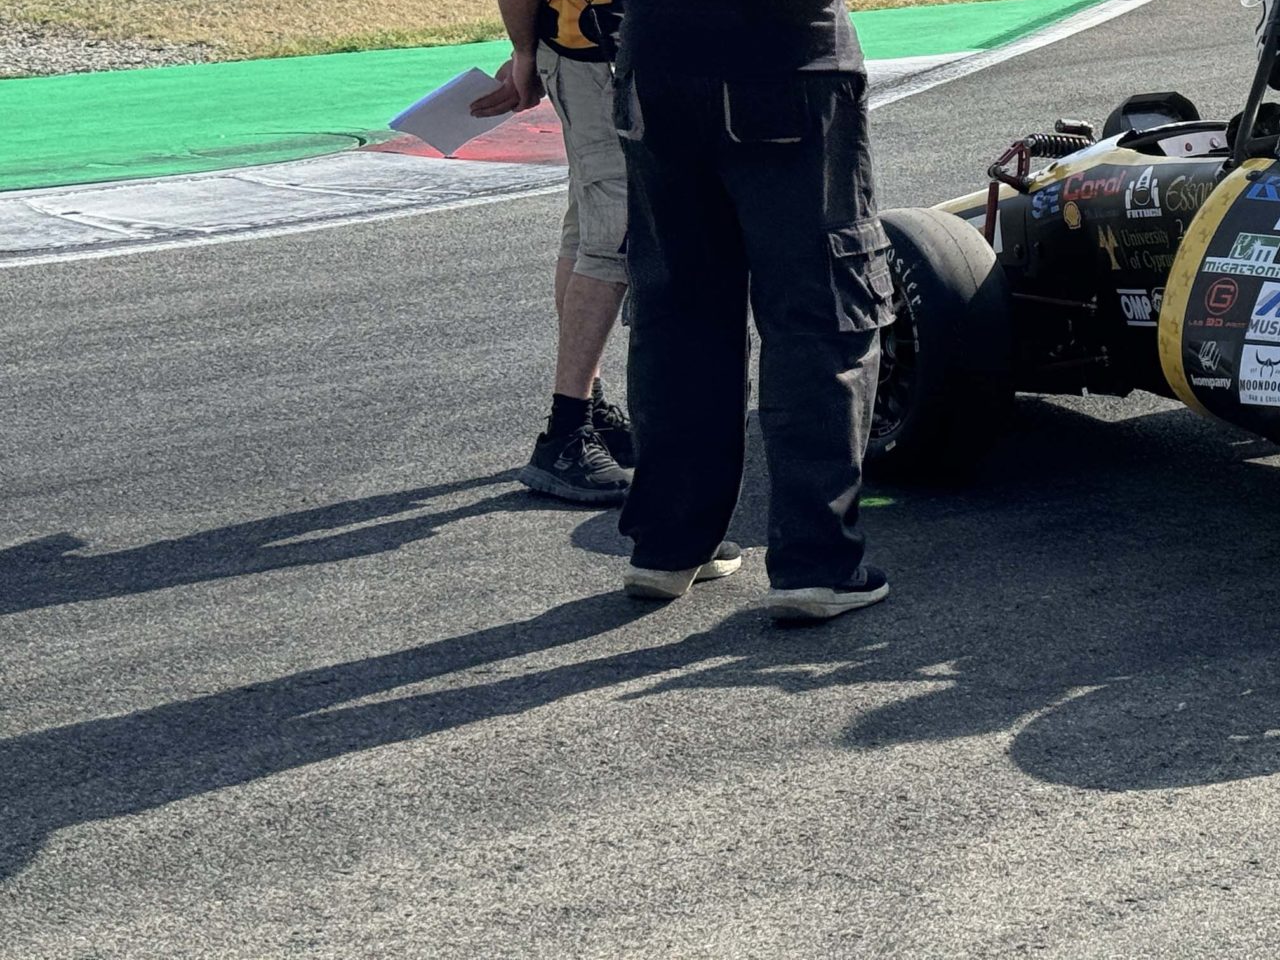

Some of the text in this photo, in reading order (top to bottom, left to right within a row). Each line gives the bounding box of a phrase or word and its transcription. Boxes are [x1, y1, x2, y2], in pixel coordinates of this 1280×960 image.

[1062, 170, 1128, 201] Coral
[1121, 228, 1169, 249] University
[1130, 251, 1141, 270] of
[886, 249, 922, 306] osier
[1120, 295, 1152, 320] OMP
[1190, 374, 1232, 390] kompany
